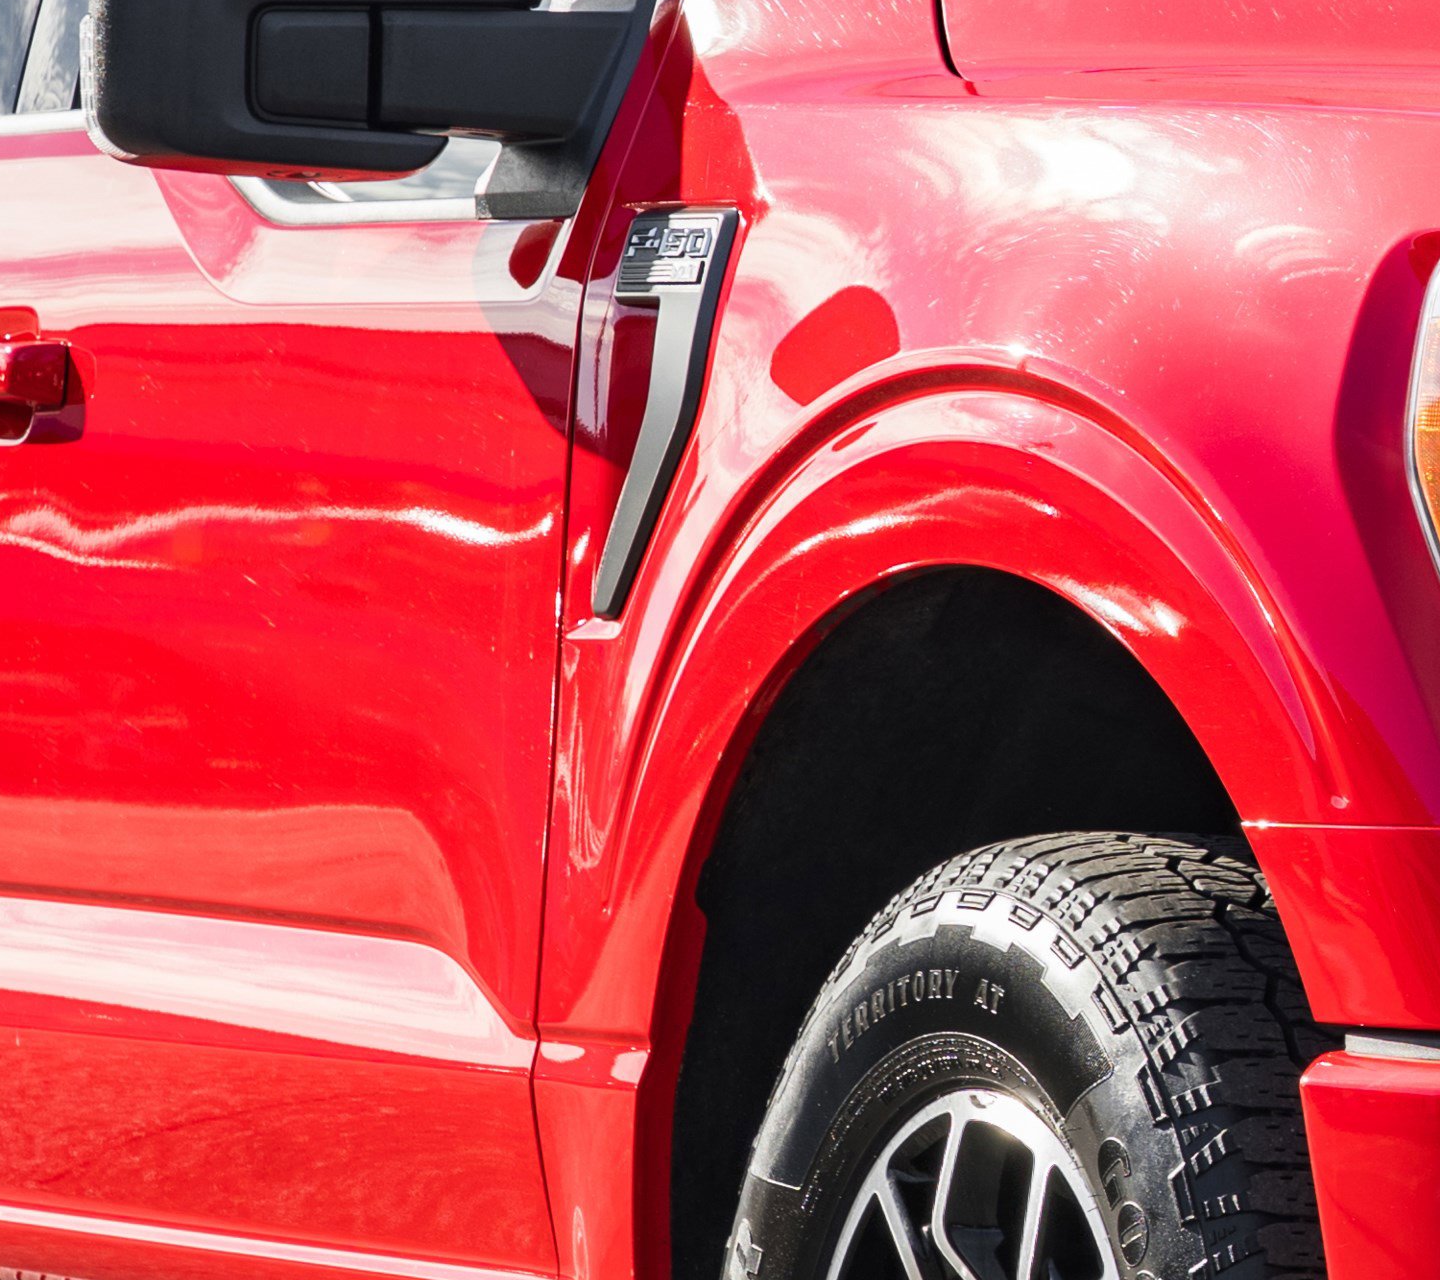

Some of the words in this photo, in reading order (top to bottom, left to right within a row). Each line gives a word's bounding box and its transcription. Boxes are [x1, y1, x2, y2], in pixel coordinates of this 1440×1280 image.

[624, 226, 713, 259] F-150
[827, 968, 960, 1064] TERRITORY
[973, 977, 1007, 1015] AT
